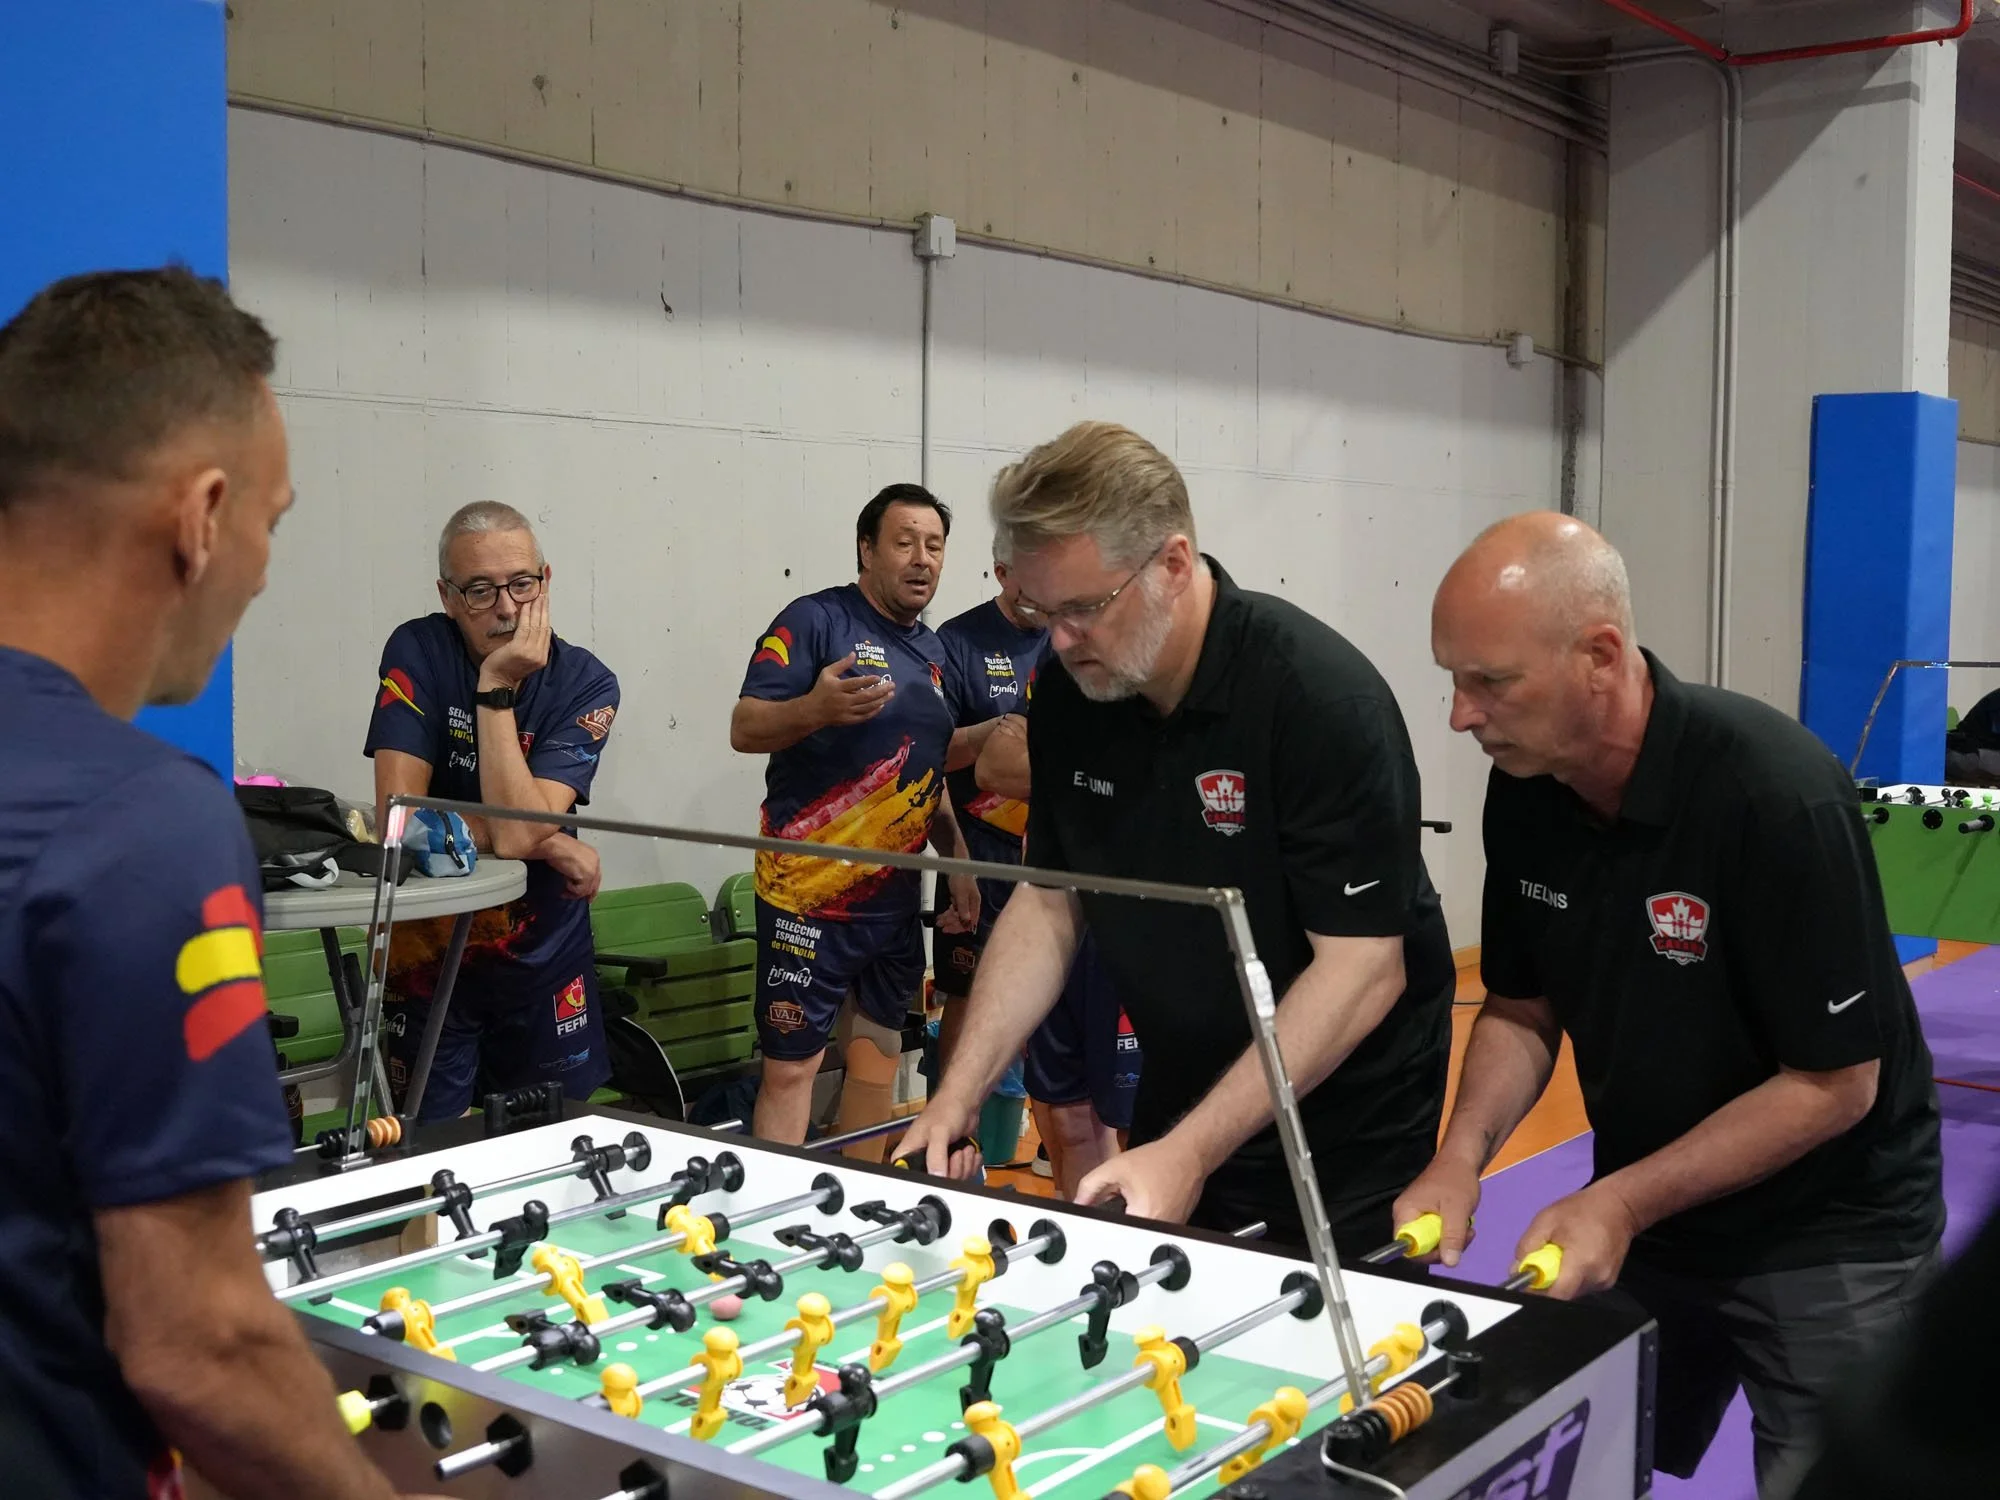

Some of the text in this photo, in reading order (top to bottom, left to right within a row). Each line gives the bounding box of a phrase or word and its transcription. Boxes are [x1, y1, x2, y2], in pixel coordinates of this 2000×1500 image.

[775, 917, 822, 939] SELECCIÓN
[771, 940, 781, 950] de
[775, 930, 815, 950] ESPAÑOLA
[557, 1014, 587, 1036] FEFM
